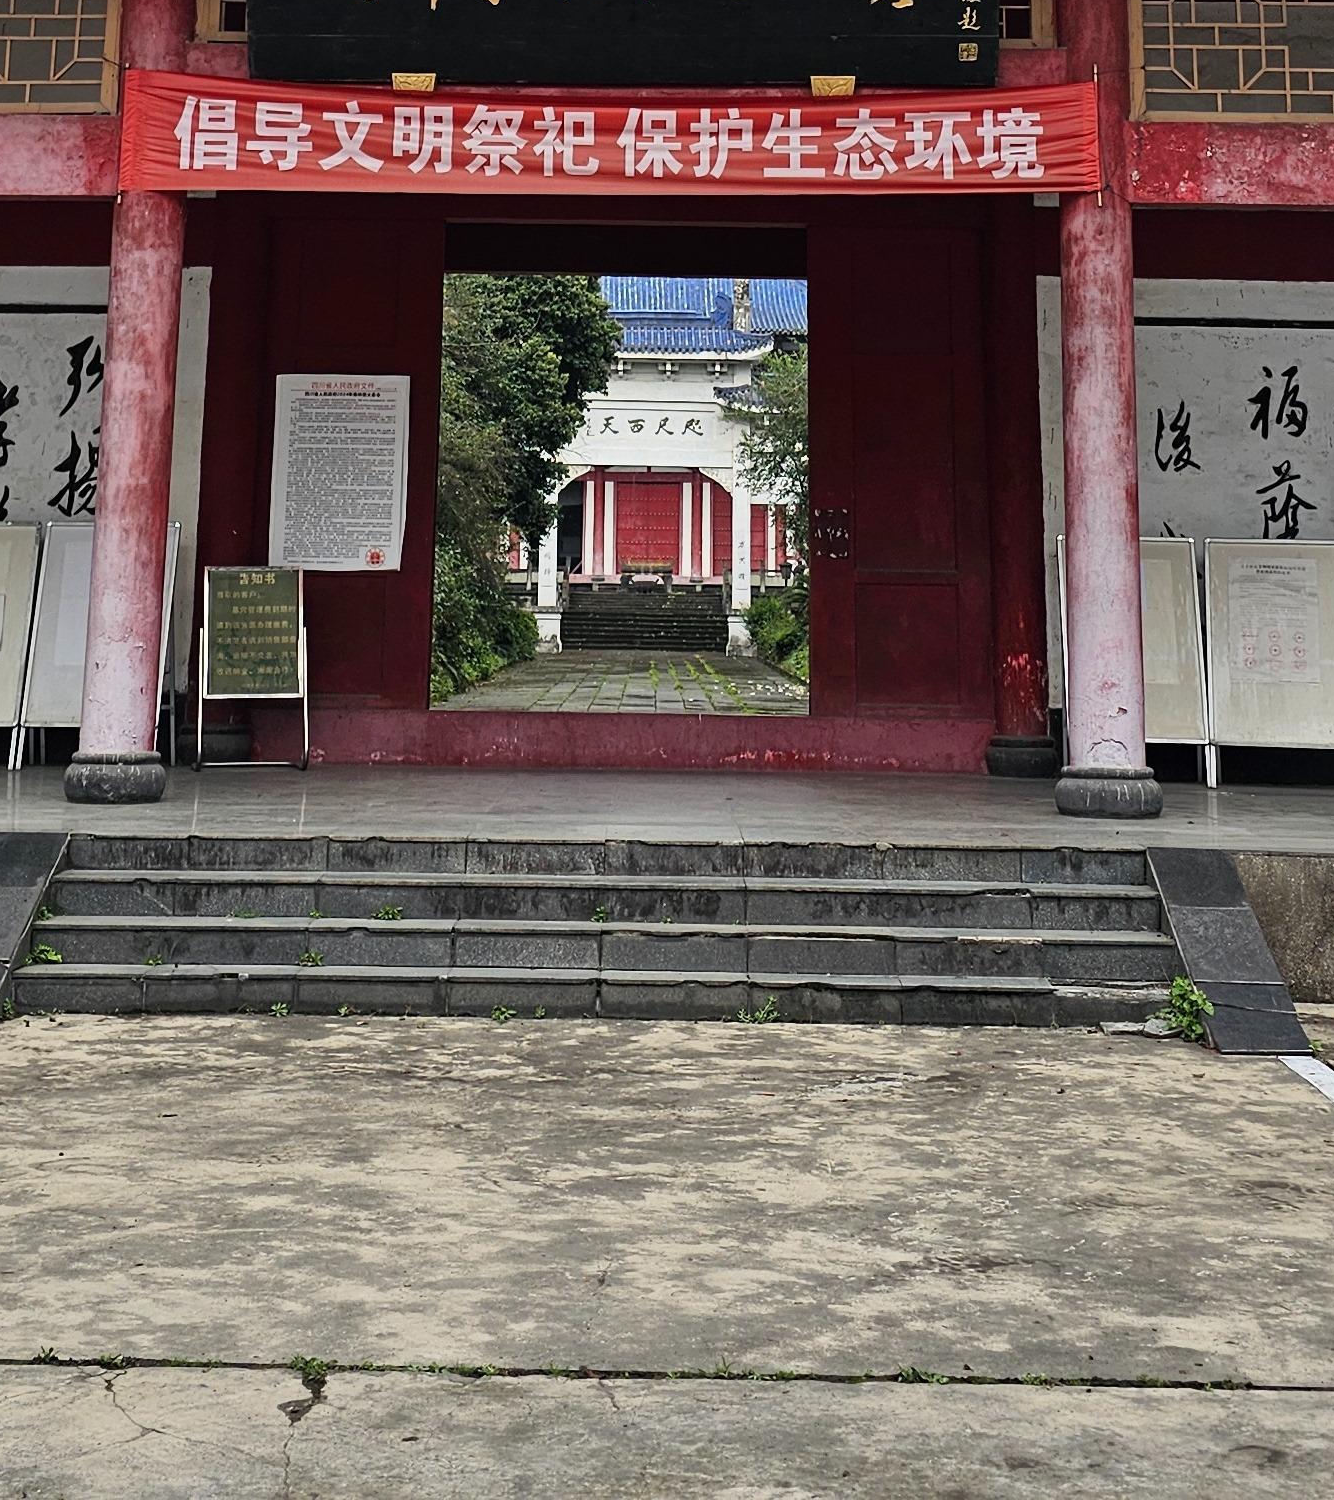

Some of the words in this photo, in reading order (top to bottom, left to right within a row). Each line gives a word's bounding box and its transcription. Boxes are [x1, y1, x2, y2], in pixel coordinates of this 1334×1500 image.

[175, 94, 596, 178] 倡导文明祭祀
[618, 107, 1046, 182] 保护生态环境
[239, 572, 276, 585] 告知书
